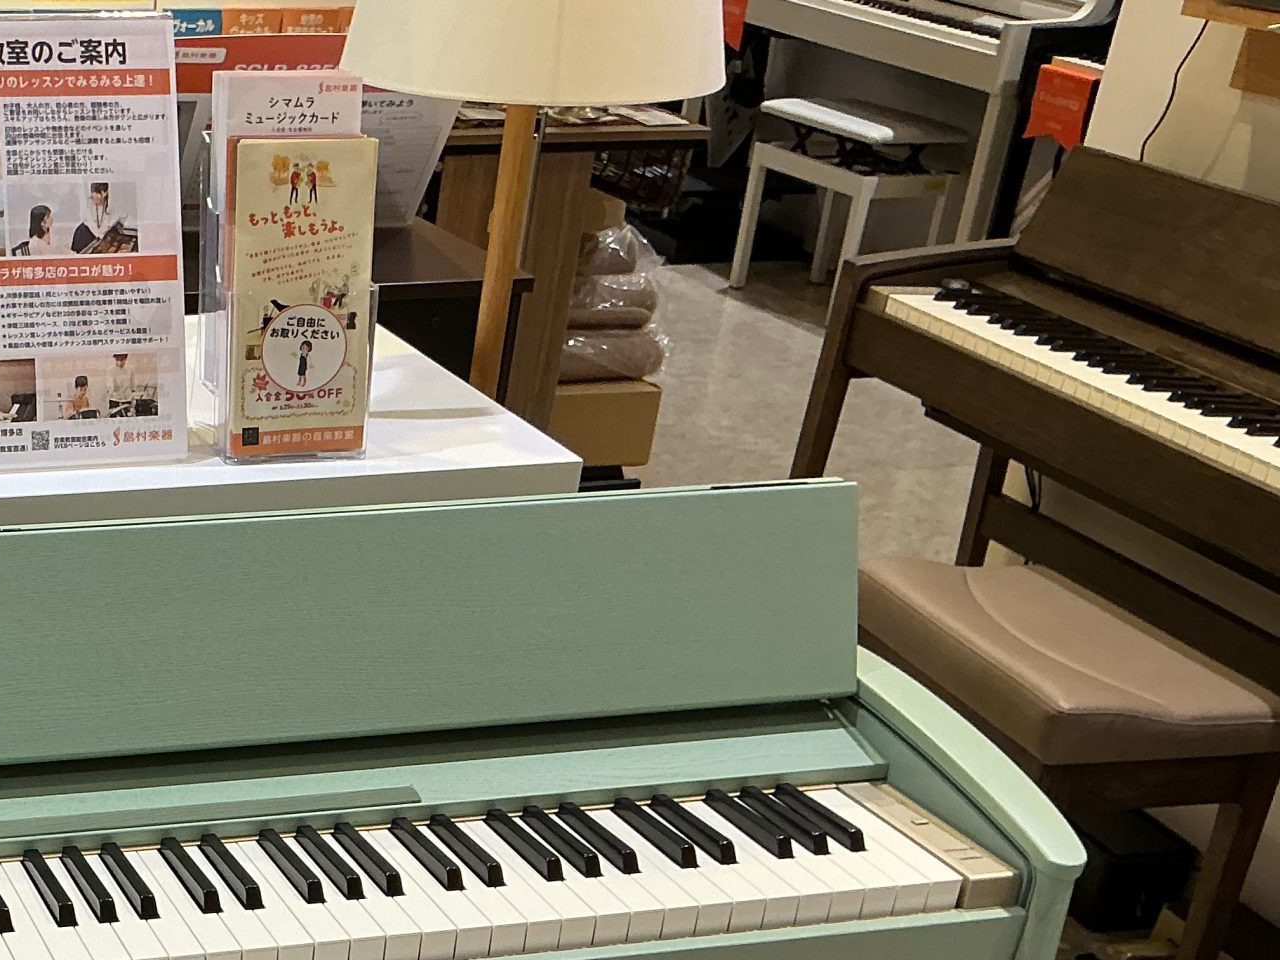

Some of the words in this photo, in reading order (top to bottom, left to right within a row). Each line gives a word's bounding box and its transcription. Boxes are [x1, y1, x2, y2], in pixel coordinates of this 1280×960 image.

[268, 96, 315, 109] シマムラ
[245, 111, 340, 125] ミュージックカード
[286, 316, 326, 329] ご自由に
[270, 326, 340, 340] お取りください
[317, 388, 343, 399] OFF
[123, 428, 173, 443] 島村楽器
